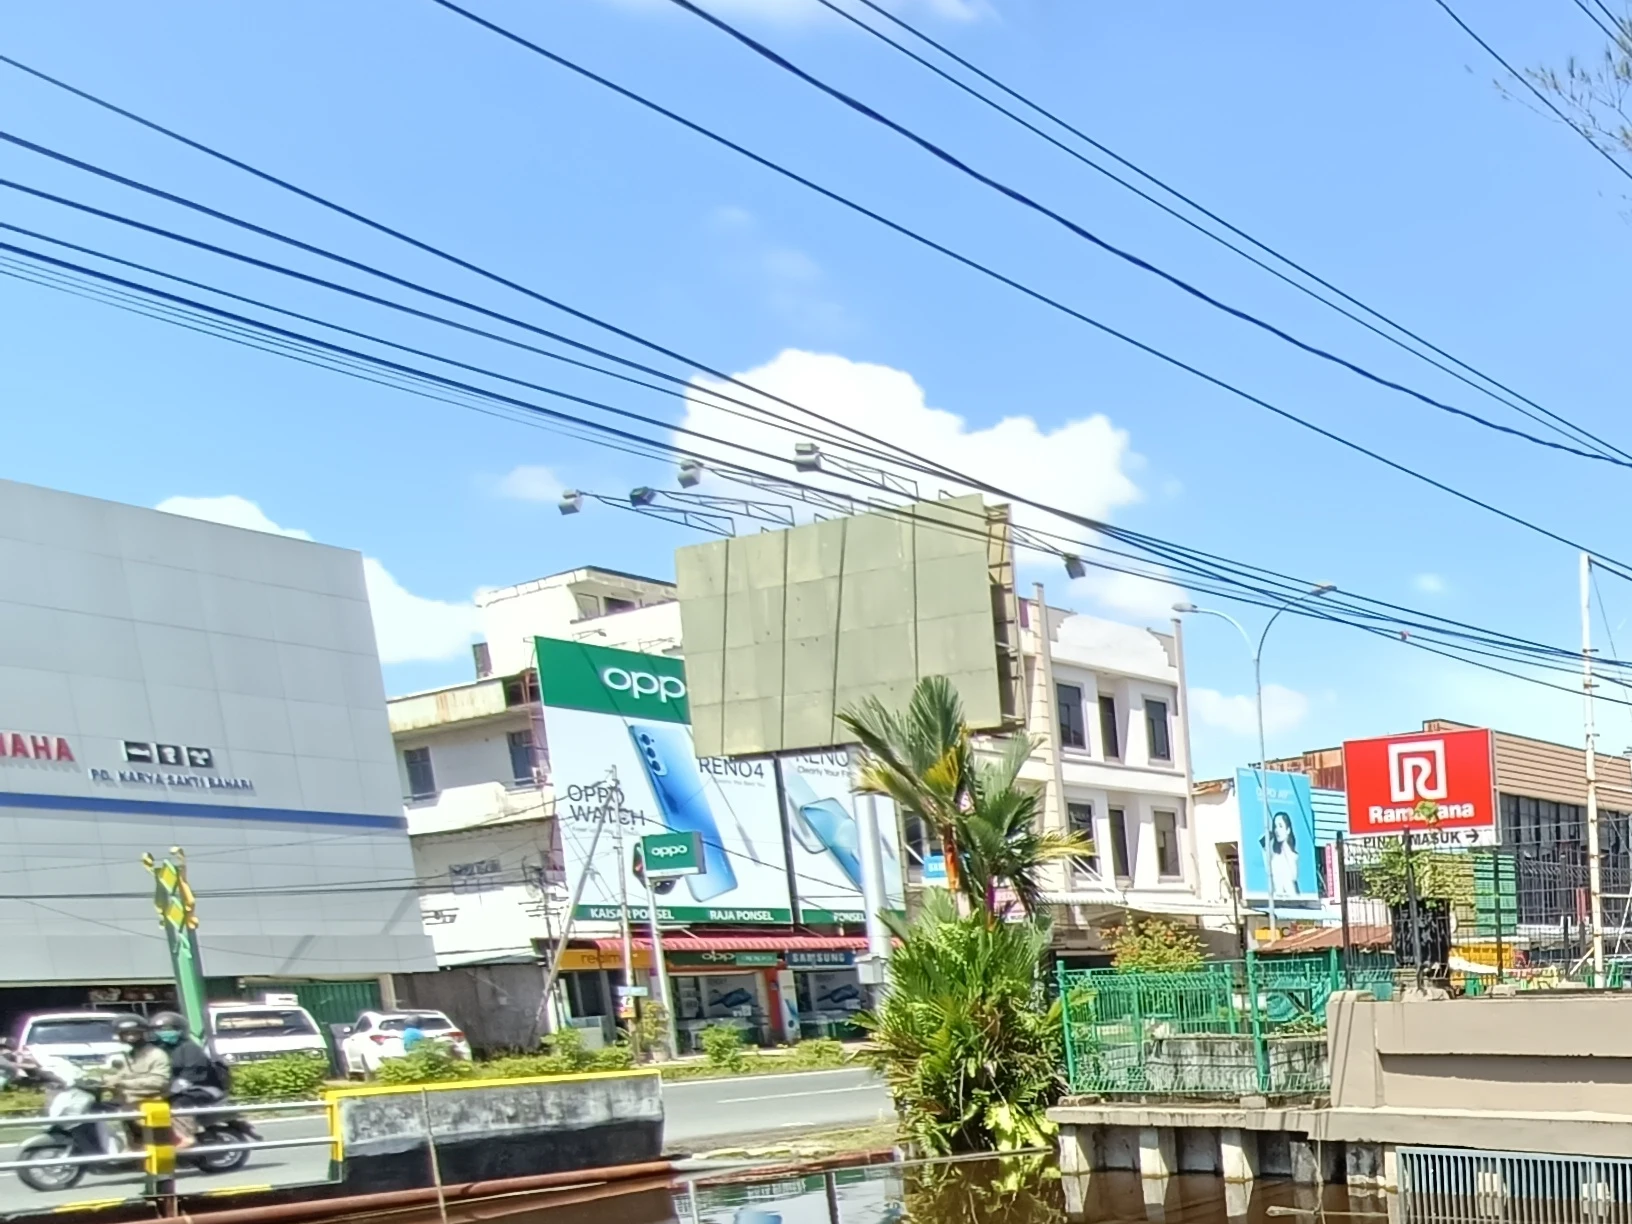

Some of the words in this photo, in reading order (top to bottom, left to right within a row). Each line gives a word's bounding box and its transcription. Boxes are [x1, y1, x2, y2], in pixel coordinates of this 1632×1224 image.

[603, 667, 686, 703] opp
[0, 732, 76, 763] AHA
[1368, 802, 1475, 824] Ramaana
[1363, 834, 1407, 849] PIN
[651, 845, 688, 858] oppo
[632, 908, 675, 920] POSEL
[709, 910, 735, 921] RAJA
[736, 910, 774, 921] PONSEL
[702, 952, 735, 962] opp
[792, 952, 845, 963] SAMSUNG
